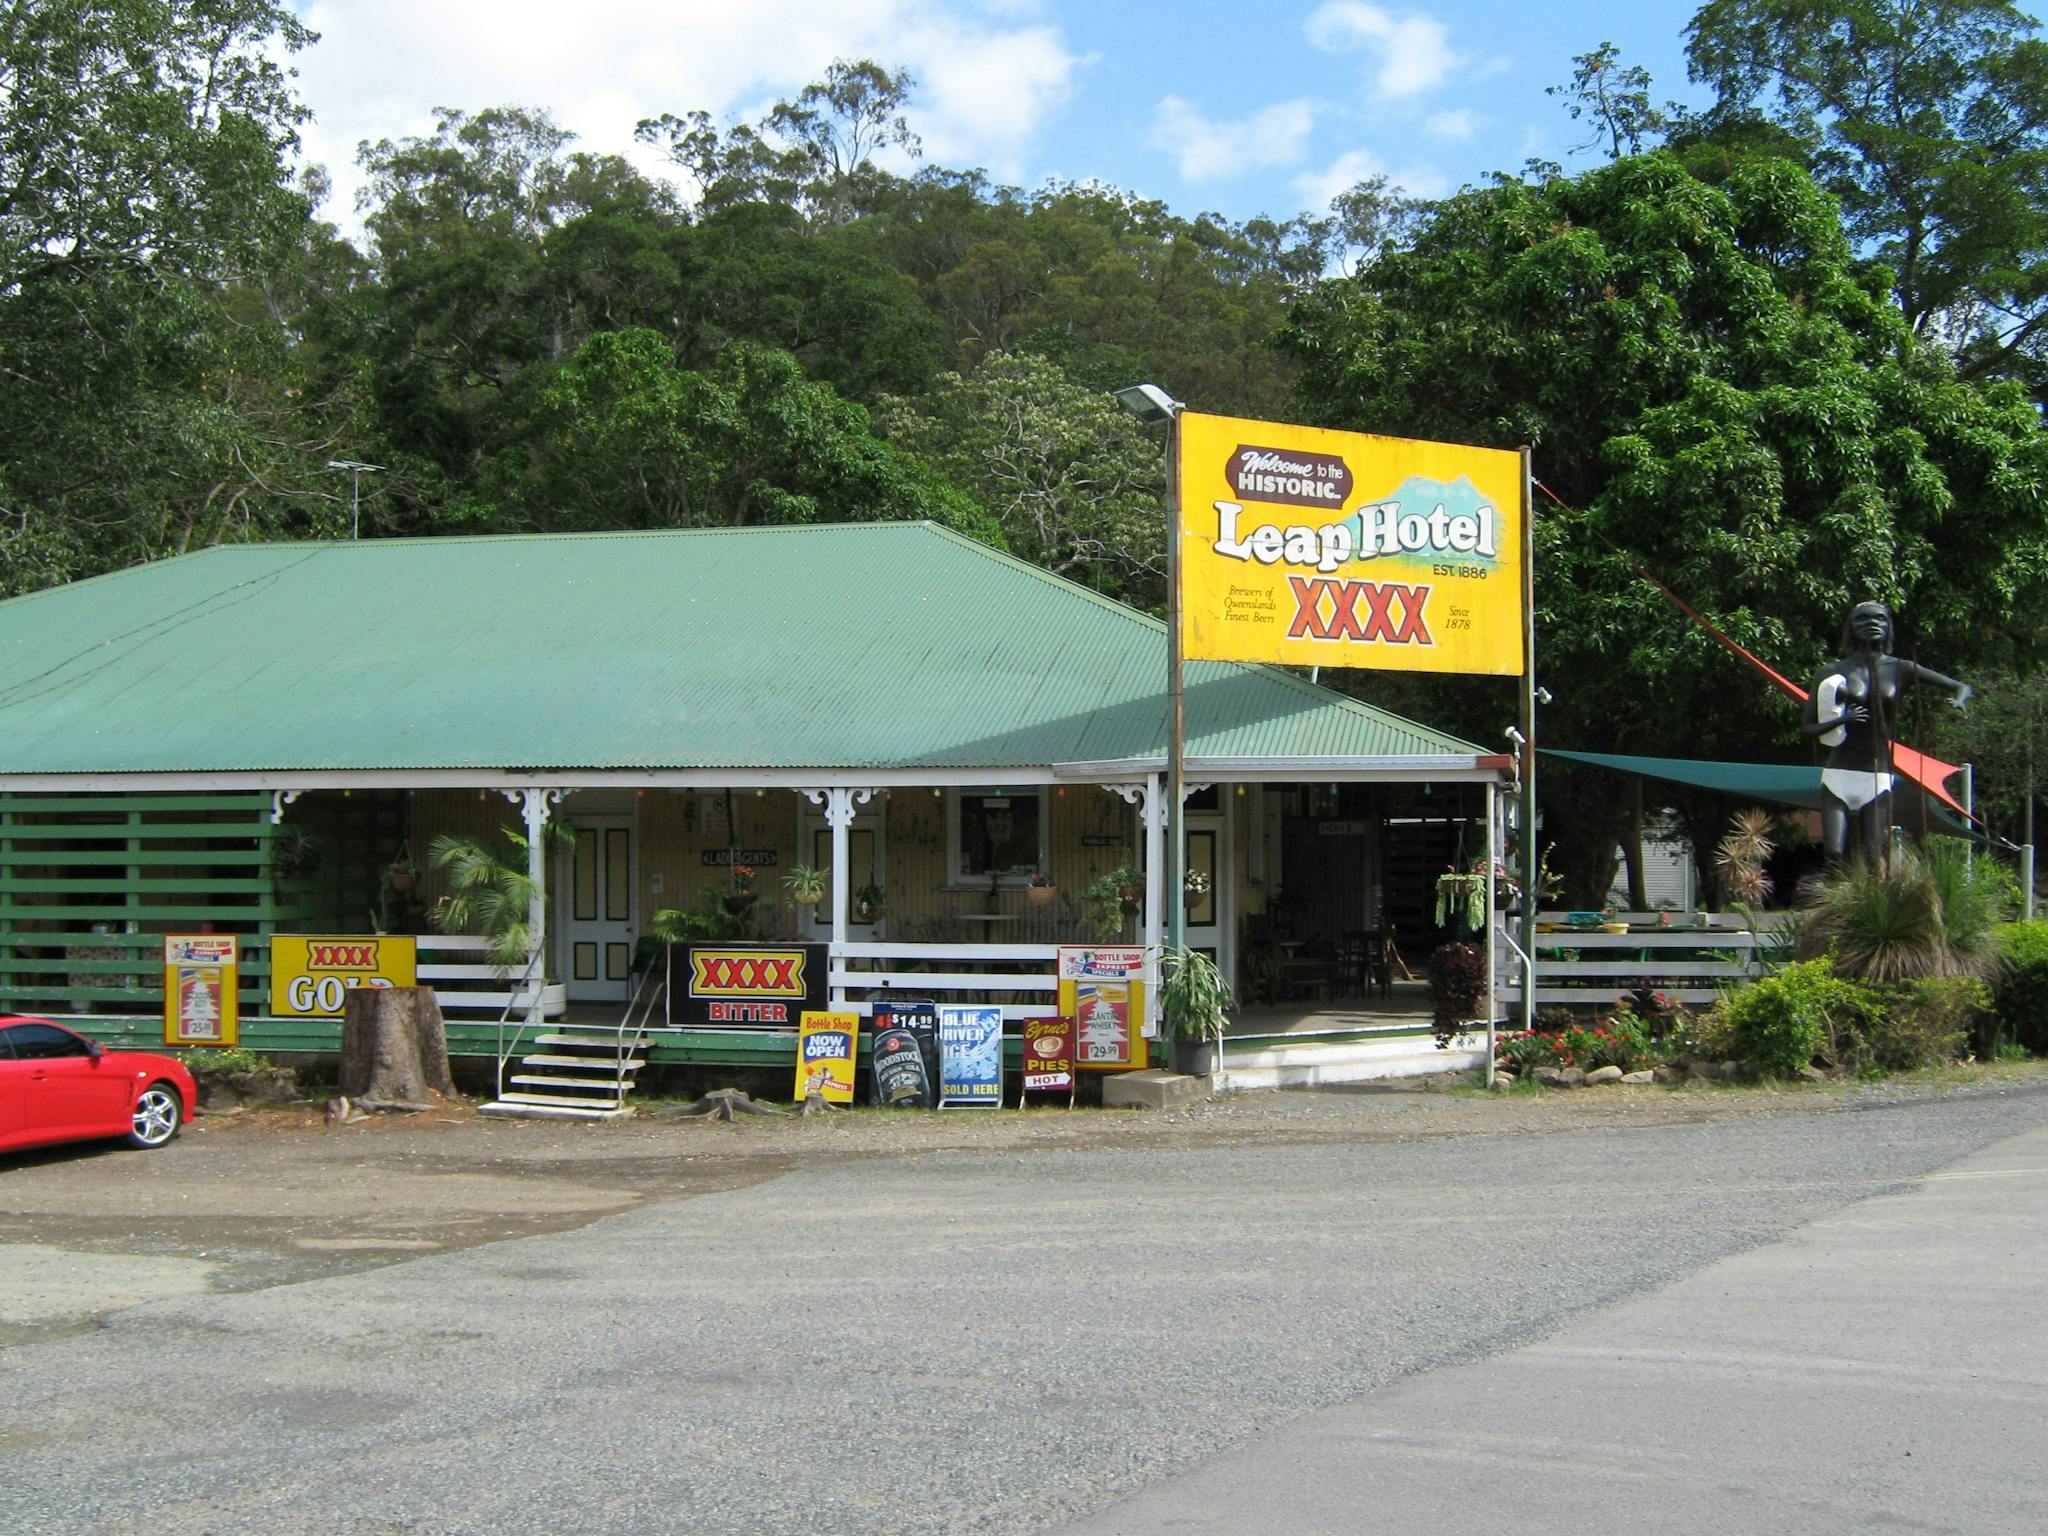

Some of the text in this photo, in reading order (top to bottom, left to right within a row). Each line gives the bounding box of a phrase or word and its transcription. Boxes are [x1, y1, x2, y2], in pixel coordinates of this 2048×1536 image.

[1241, 451, 1344, 479] Welcome to the
[1213, 500, 1497, 573] Leap Hotel
[1458, 566, 1488, 580] 1886
[1229, 584, 1275, 601] Brewers of
[1223, 596, 1277, 611] Queenslands
[1287, 576, 1433, 645] XXXX
[1448, 604, 1471, 617] Since
[1224, 610, 1275, 623] Finest Beers
[1445, 618, 1472, 631] 1878
[709, 851, 741, 865] LADIS
[313, 945, 372, 966] XXXX
[1094, 953, 1142, 962] BOTTLE SHOP
[699, 957, 796, 990] XXXX
[1091, 968, 1120, 976] SPECIALS
[287, 975, 395, 1013] GO
[709, 1001, 788, 1022] BITTER
[943, 1011, 980, 1026] BLUE
[806, 1016, 853, 1031] Bottle Shop
[808, 1034, 845, 1047] NOW
[943, 1027, 985, 1041] RIVER
[805, 1045, 846, 1057] OPEN
[943, 1042, 971, 1059] ICE
[1027, 1059, 1070, 1072] PIES
[1032, 1074, 1060, 1086] HOT
[943, 1084, 999, 1095] SOLD HERE
